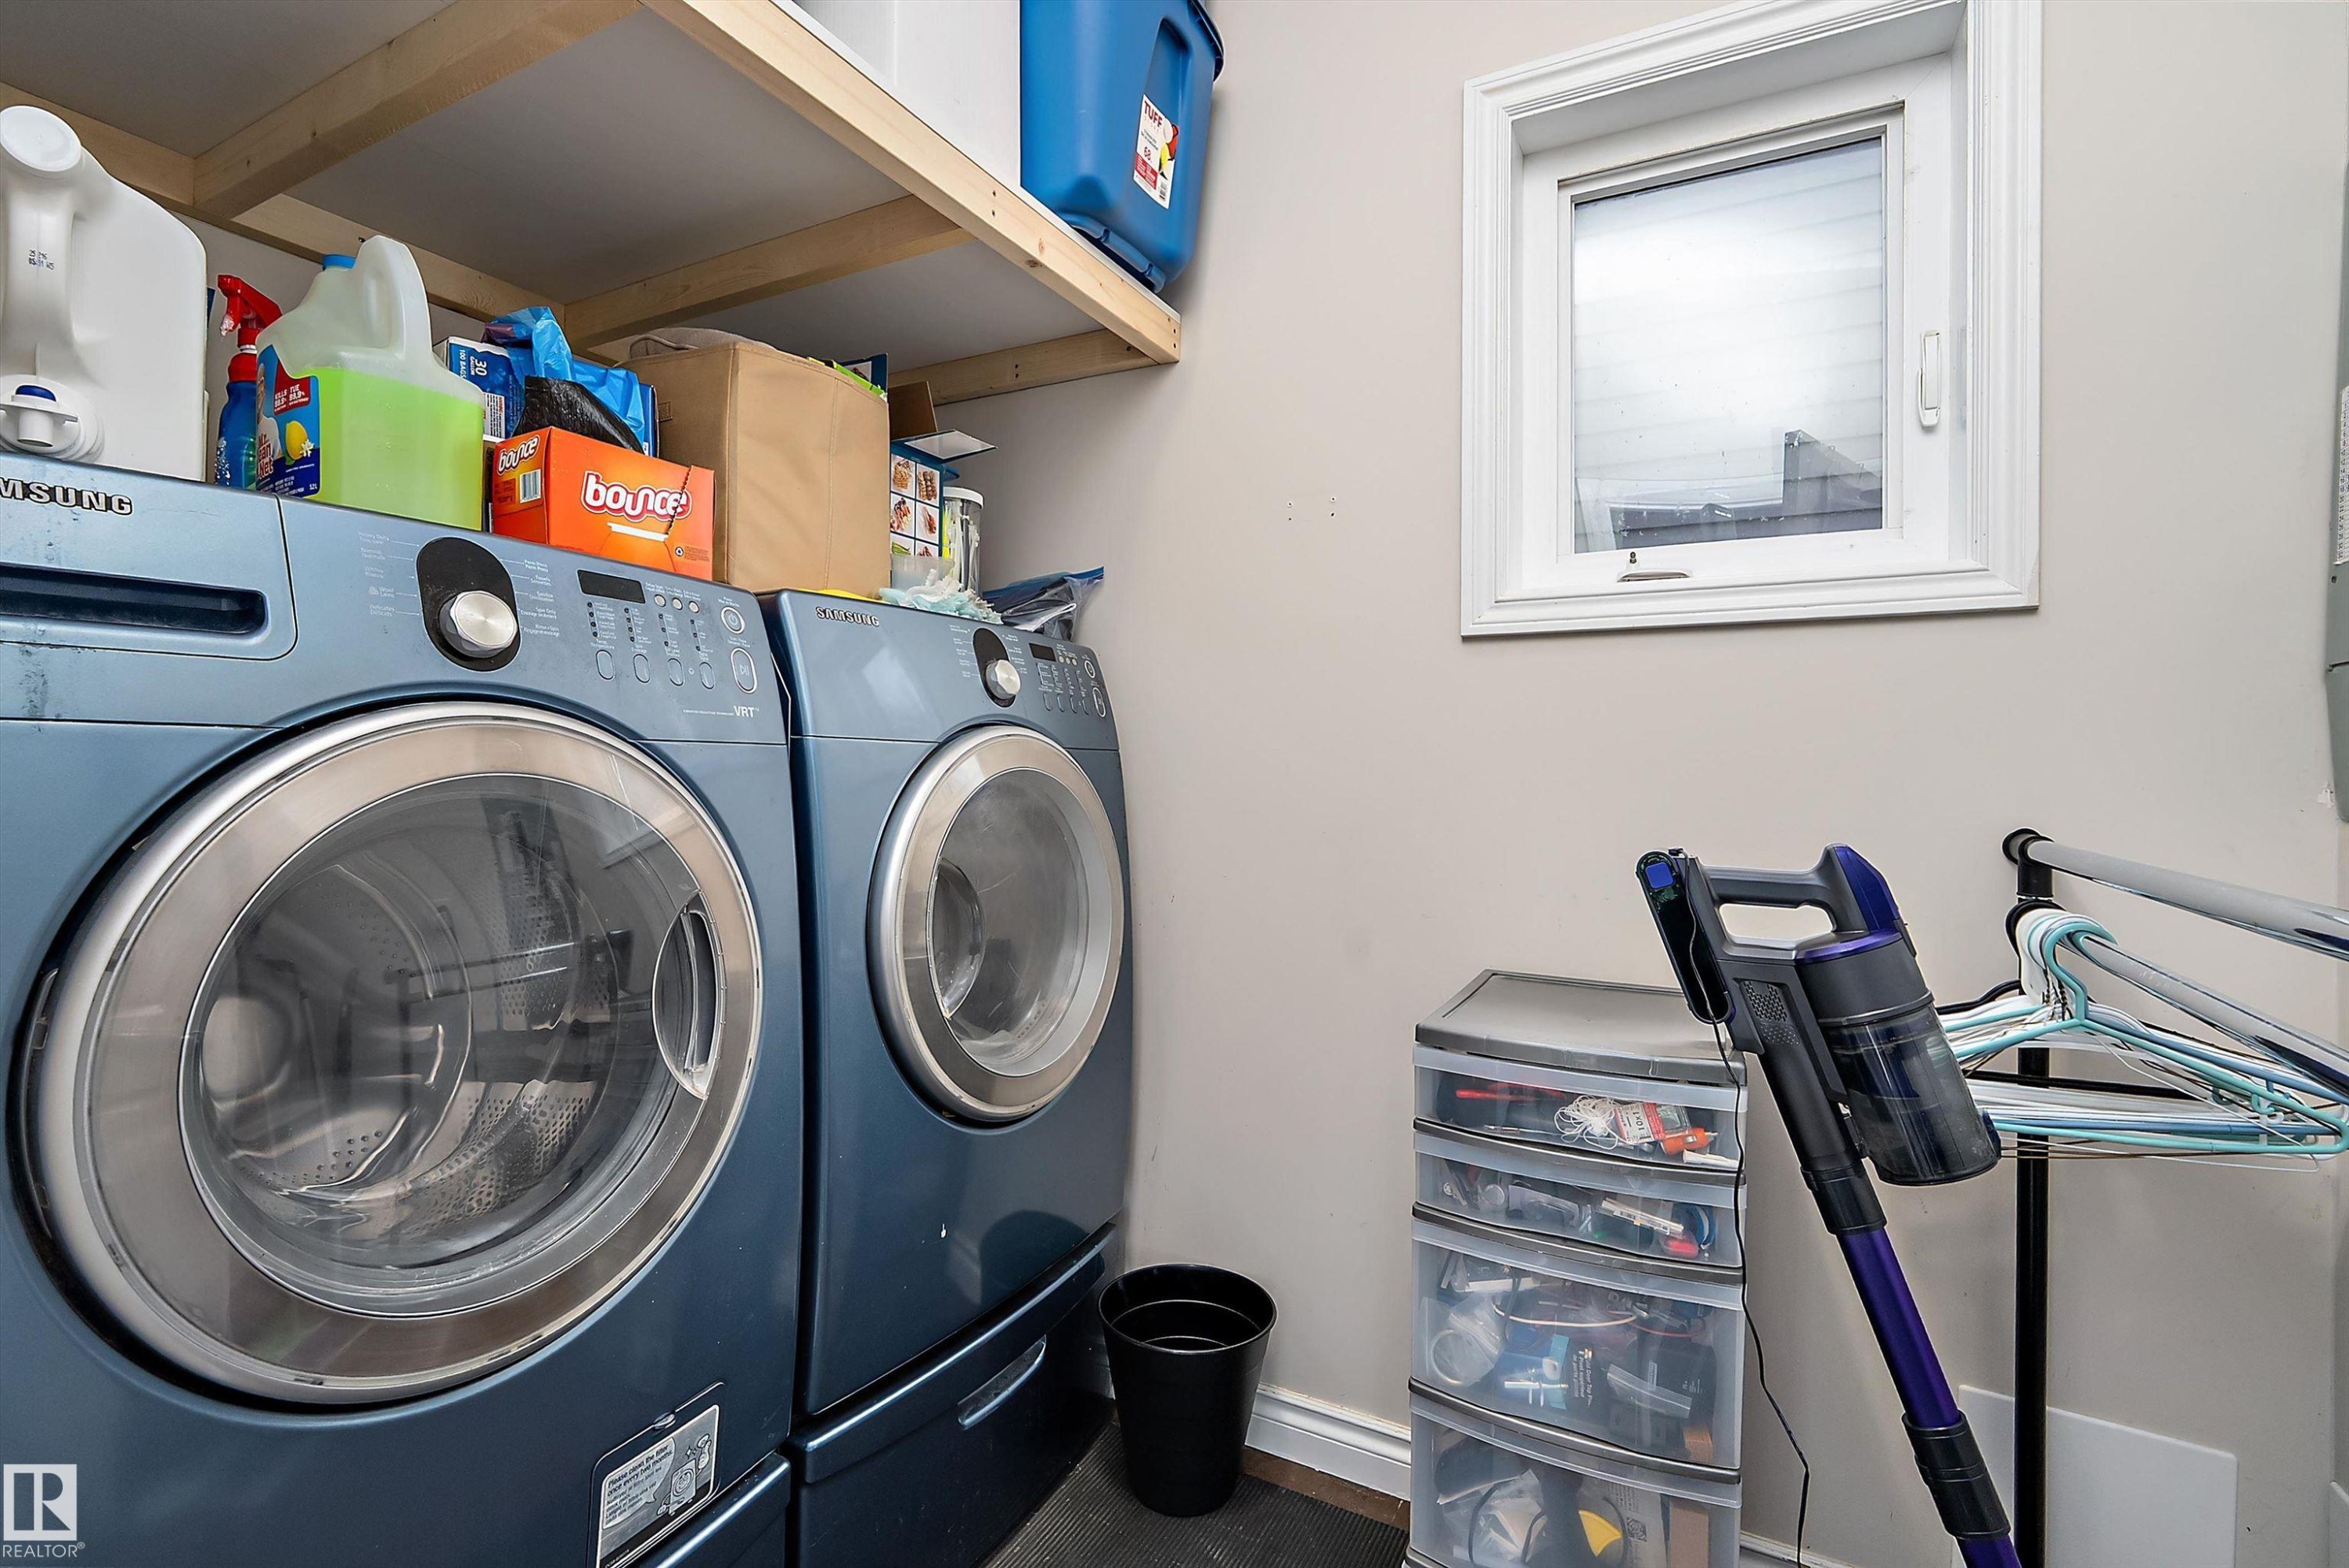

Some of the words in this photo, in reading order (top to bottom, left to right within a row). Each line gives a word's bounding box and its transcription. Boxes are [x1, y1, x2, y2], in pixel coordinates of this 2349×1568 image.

[1145, 100, 1163, 128] TUFF
[475, 359, 487, 376] 30
[498, 436, 539, 473] bounce
[583, 472, 690, 520] bounce
[816, 607, 879, 627] SAMSUNG
[608, 1472, 627, 1488] Please
[629, 1461, 644, 1475] clean
[645, 1454, 655, 1464] the
[608, 1483, 622, 1496] once
[623, 1472, 640, 1487] every
[640, 1465, 651, 1475] two
